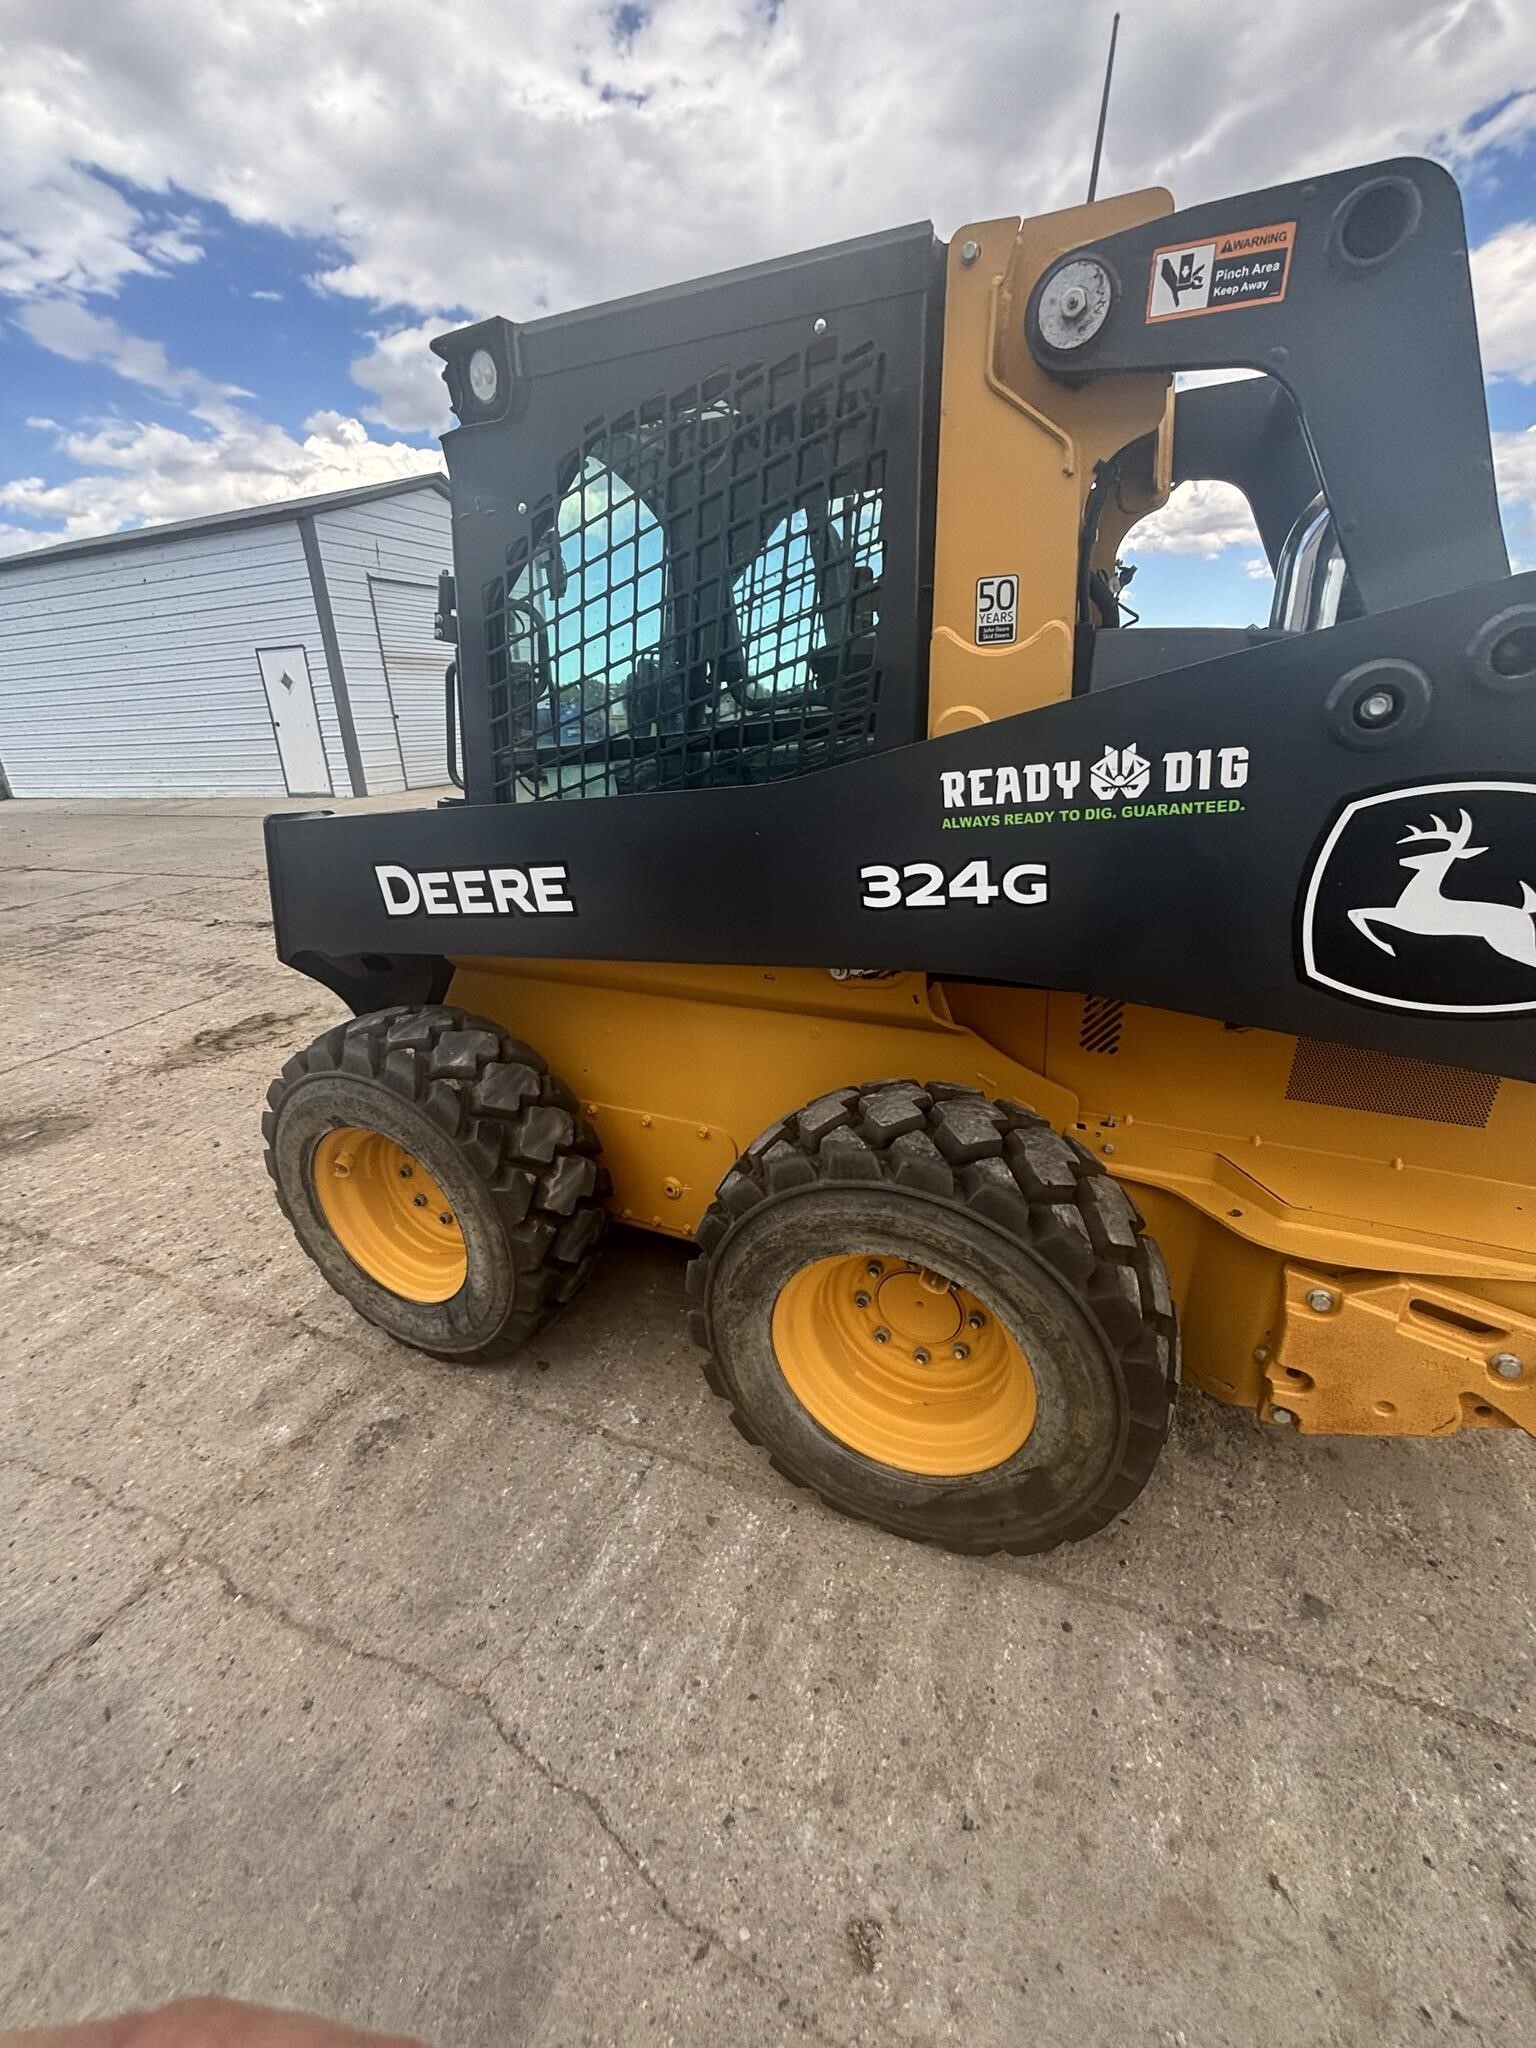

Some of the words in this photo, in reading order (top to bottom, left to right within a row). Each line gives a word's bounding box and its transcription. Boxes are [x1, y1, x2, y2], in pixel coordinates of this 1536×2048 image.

[1232, 231, 1287, 250] WARNING
[1215, 266, 1249, 281] Pinch
[1251, 261, 1280, 275] Area
[1213, 284, 1239, 297] Keep
[1240, 279, 1269, 293] Away
[979, 579, 1015, 612] 50
[979, 611, 1014, 624] YEARS
[940, 760, 1081, 808] READY
[1161, 747, 1249, 792] DIG
[941, 814, 1000, 829] ALWAYS
[1004, 811, 1055, 825] READY
[1059, 809, 1081, 822] TO
[1085, 807, 1117, 820] DIG.
[1121, 799, 1246, 818] GUARANTEED.
[374, 865, 574, 915] DEERE
[860, 860, 1048, 908] 324G
